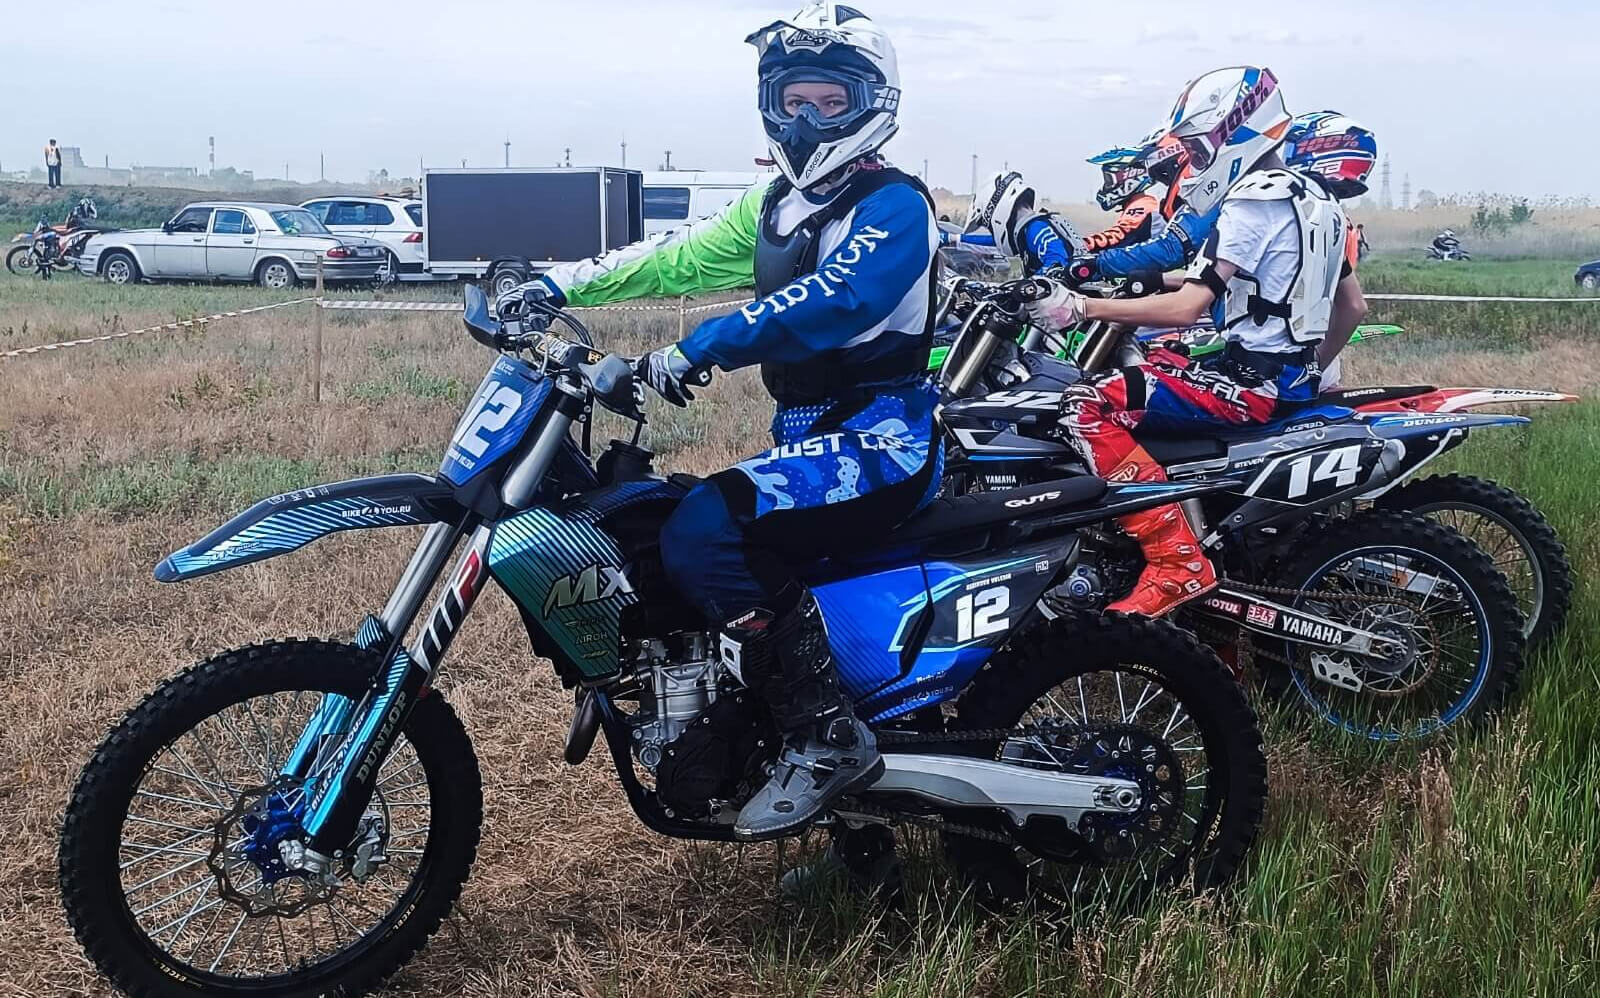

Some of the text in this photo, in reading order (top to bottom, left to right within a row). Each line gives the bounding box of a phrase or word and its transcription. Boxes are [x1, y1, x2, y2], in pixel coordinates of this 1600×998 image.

[1343, 388, 1386, 398] HONDA
[1491, 388, 1555, 397] DUNLOP
[453, 380, 522, 458] 12
[1402, 416, 1467, 428] DUNLOP
[767, 433, 845, 461] JUST
[1234, 457, 1265, 469] STEVEN
[1288, 444, 1362, 499] 14
[985, 475, 1016, 484] YAMAHA
[1004, 491, 1063, 508] GUTS
[341, 509, 361, 518] BIKE
[956, 585, 1010, 643] 12
[1282, 615, 1342, 645] YAMAHA
[355, 690, 407, 785] DUNLOP
